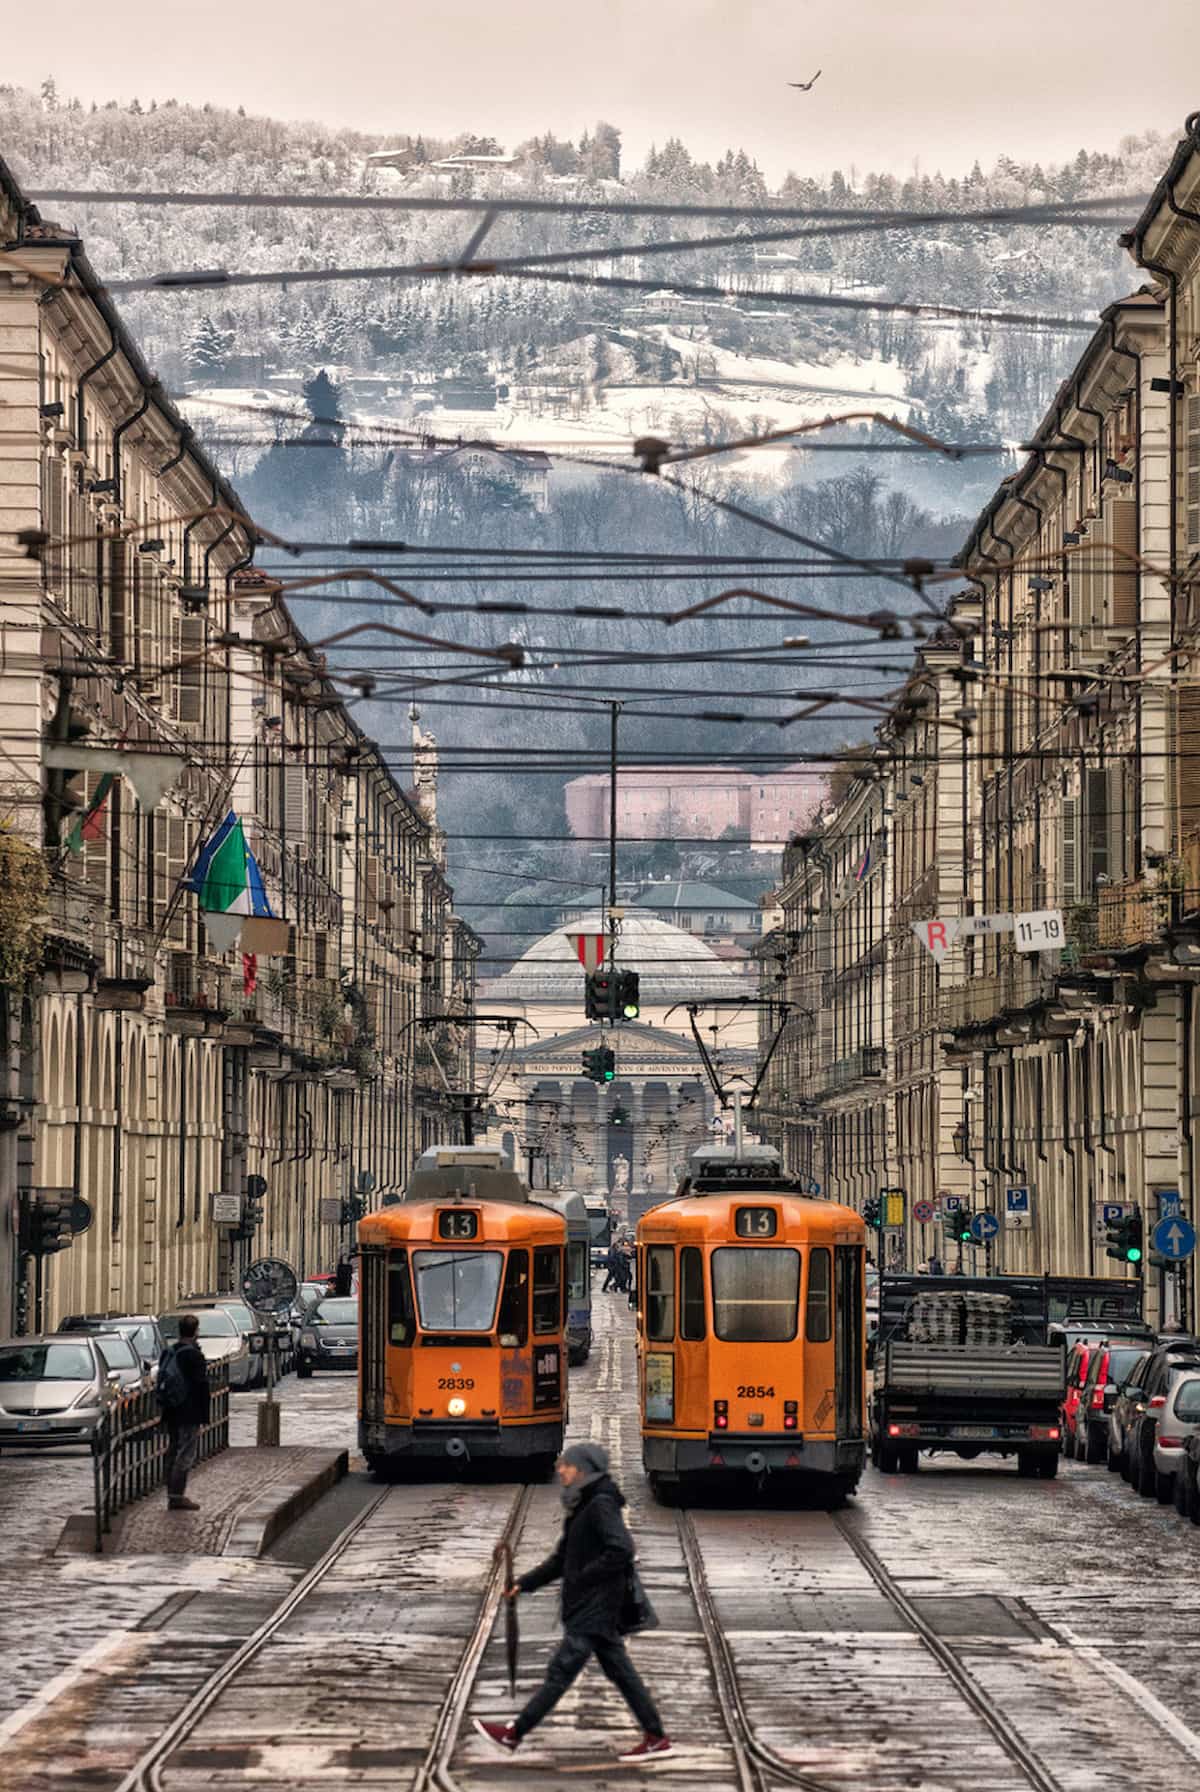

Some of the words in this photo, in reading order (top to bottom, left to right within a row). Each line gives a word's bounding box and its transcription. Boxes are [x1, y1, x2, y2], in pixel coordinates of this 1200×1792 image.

[974, 919, 991, 929] FINE
[927, 922, 947, 950] R
[1018, 919, 1060, 942] 11-19
[1012, 1191, 1022, 1204] P
[950, 1200, 958, 1210] P
[1108, 1207, 1119, 1218] P
[447, 1214, 472, 1236] 13
[744, 1211, 769, 1233] 13
[438, 1378, 475, 1390] 2839
[737, 1386, 775, 1398] 2854
